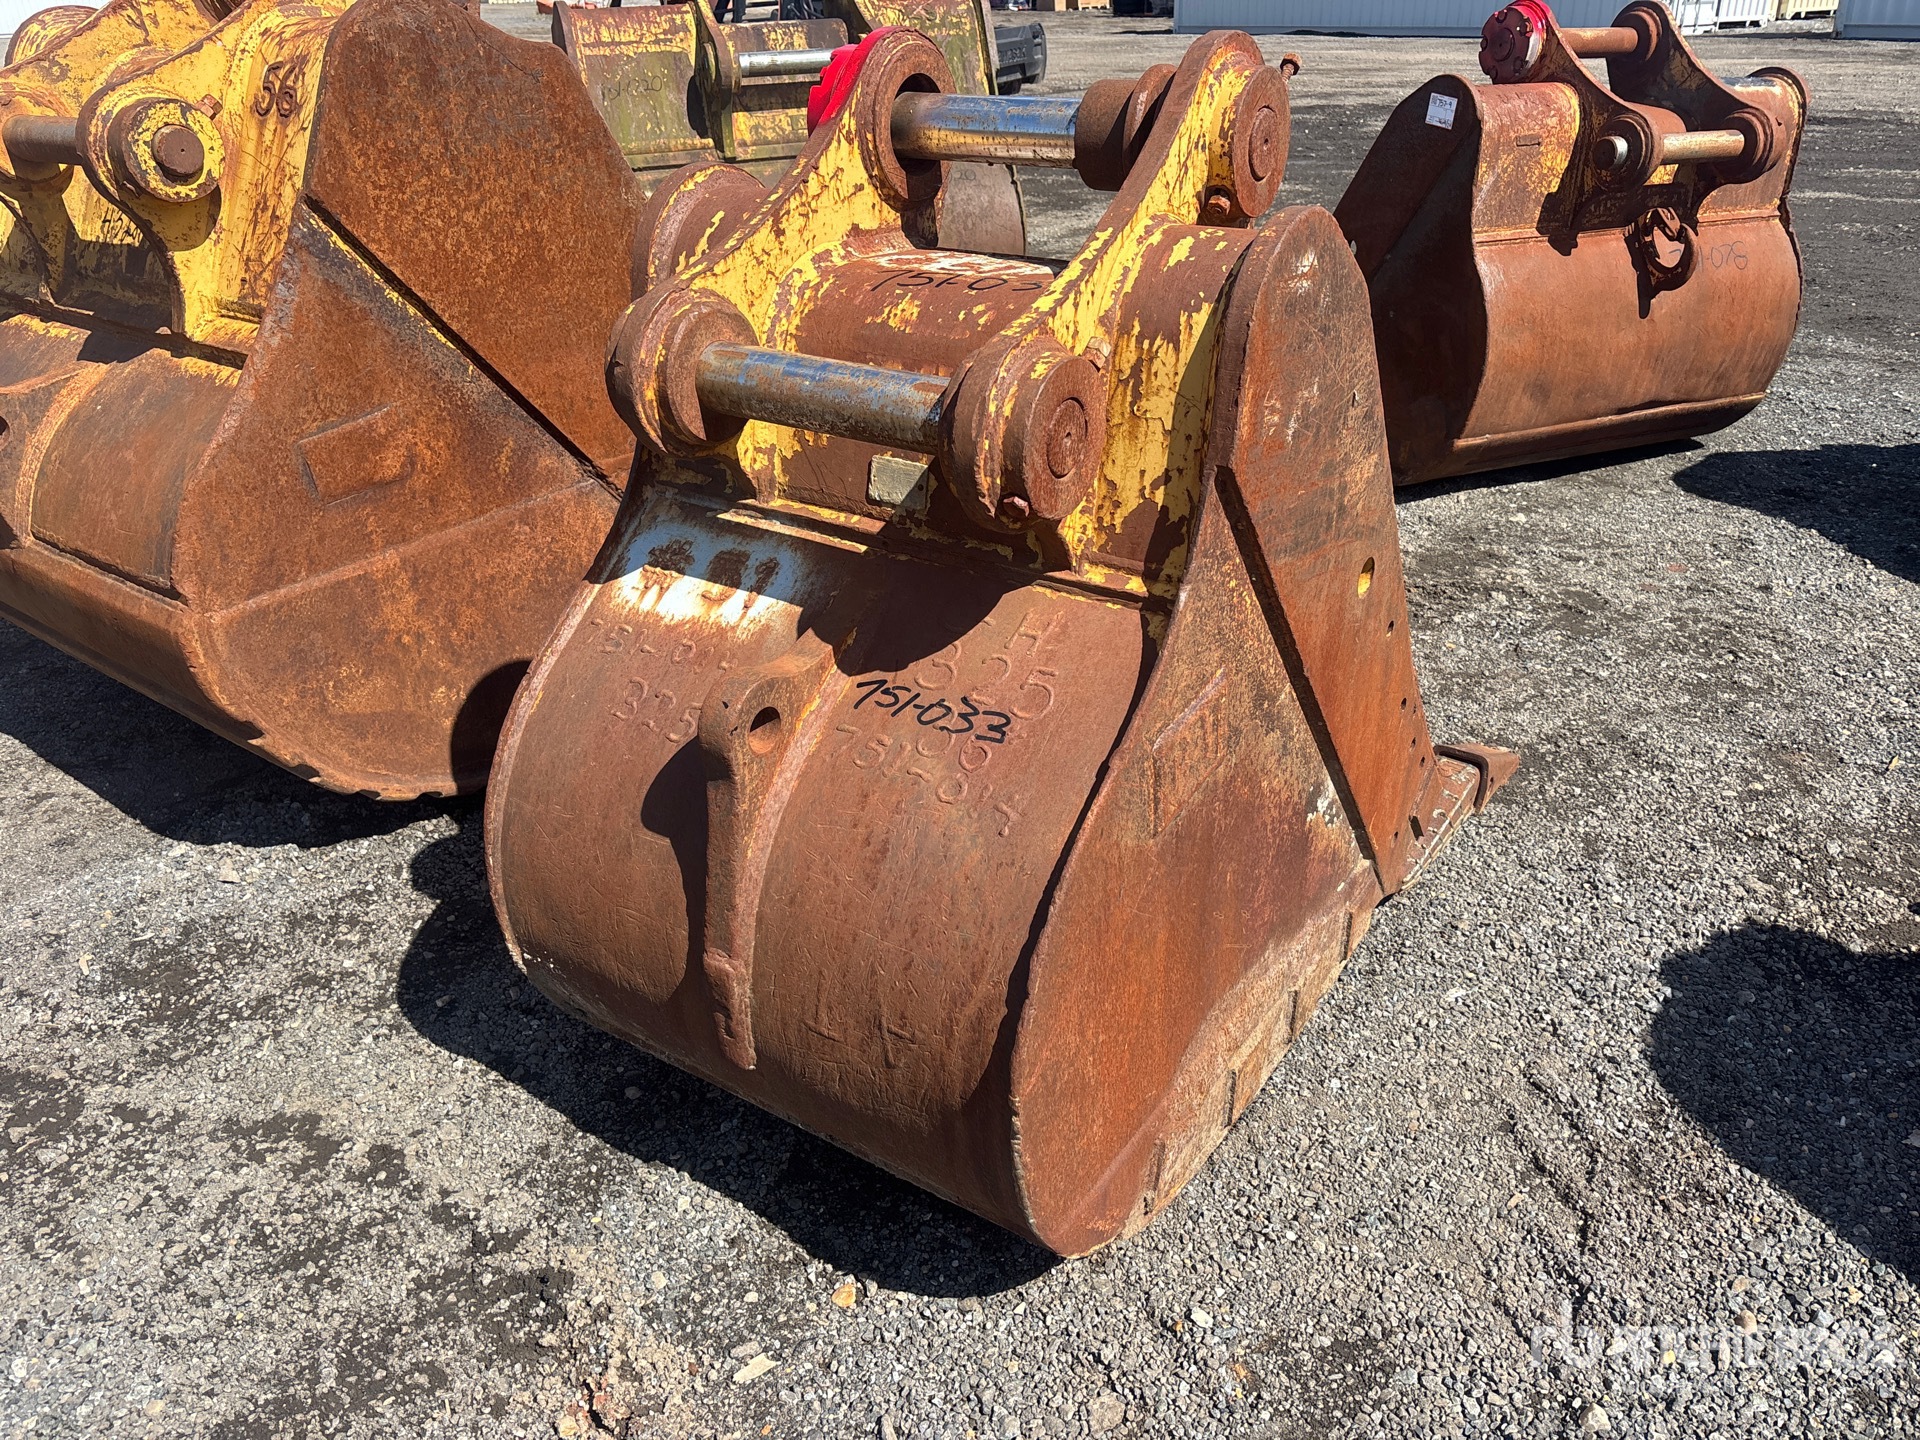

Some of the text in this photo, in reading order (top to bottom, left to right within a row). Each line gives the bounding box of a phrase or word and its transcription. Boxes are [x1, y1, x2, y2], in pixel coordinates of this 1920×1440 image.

[254, 60, 298, 118] 56
[609, 676, 702, 744] 325
[853, 678, 1012, 744] 751-033
